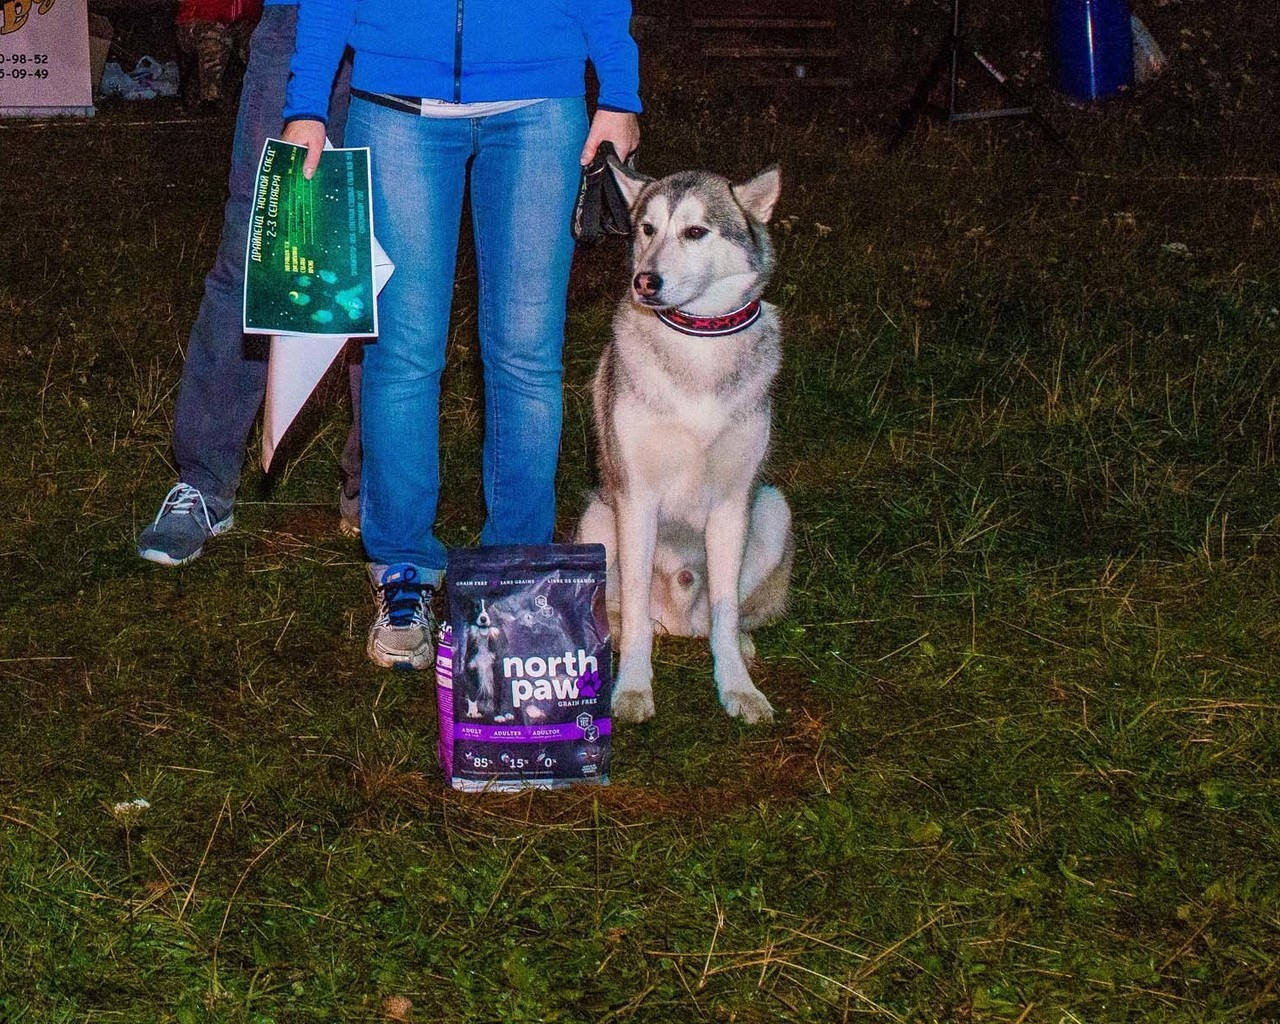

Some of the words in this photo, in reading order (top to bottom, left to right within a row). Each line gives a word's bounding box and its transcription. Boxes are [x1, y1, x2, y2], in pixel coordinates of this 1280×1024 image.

[268, 174, 281, 218] СЕНТЯБРЯ
[251, 215, 264, 263] ДРАЙЛЕНД
[266, 220, 277, 238] 2-3
[503, 649, 598, 678] north
[512, 677, 580, 707] paw
